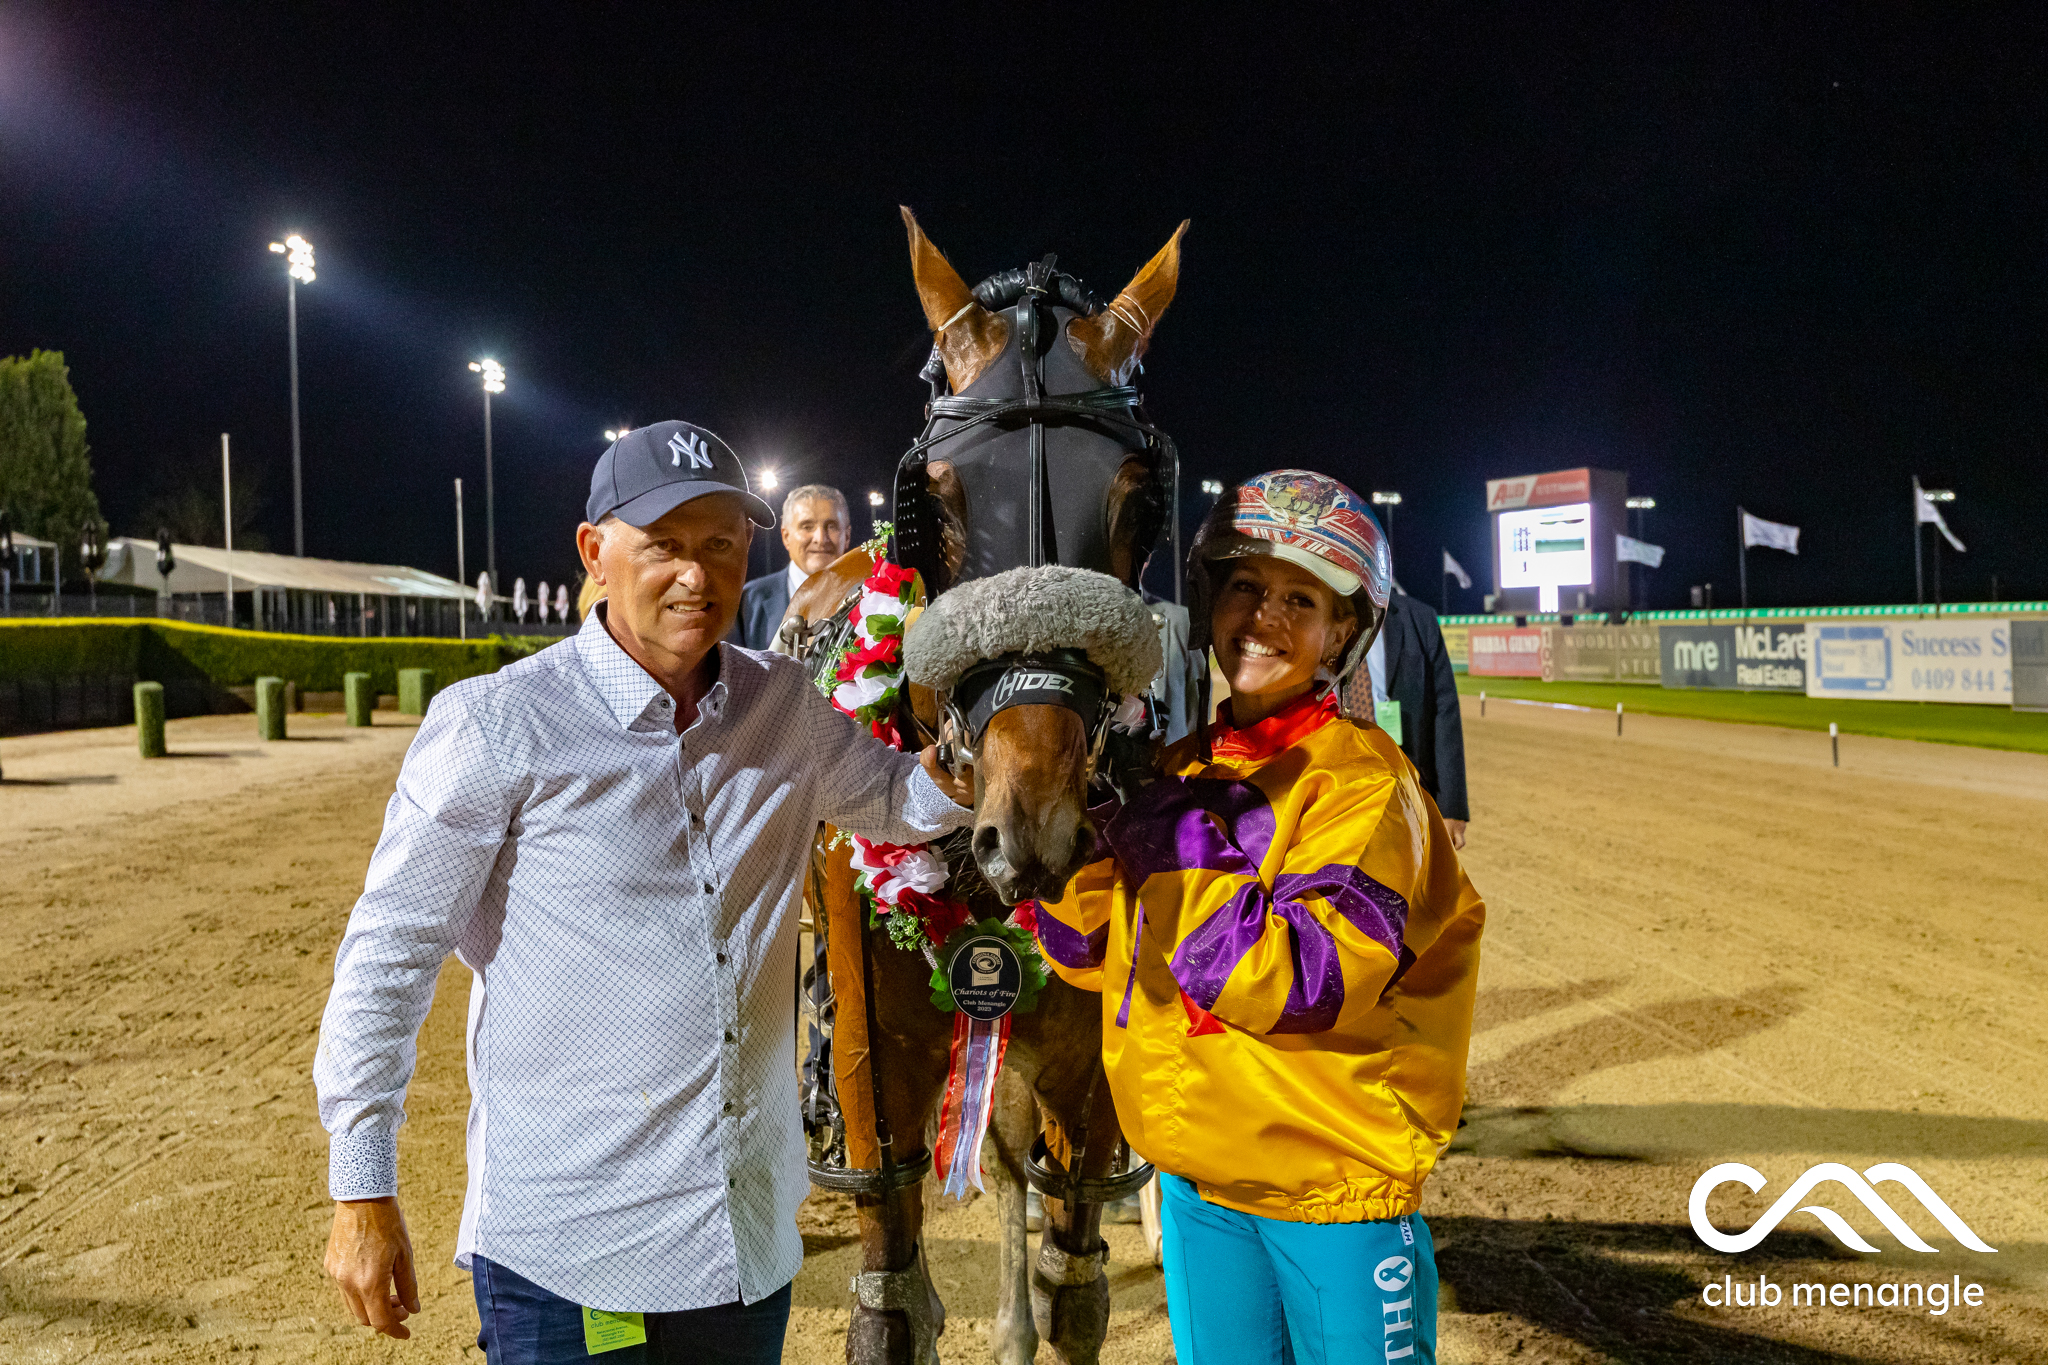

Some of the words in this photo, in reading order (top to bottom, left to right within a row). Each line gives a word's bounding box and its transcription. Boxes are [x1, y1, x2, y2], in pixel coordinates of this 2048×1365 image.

[668, 432, 714, 469] NY
[1674, 640, 1720, 671] mre
[1902, 629, 1982, 657] Success
[995, 669, 1075, 706] HIDEZ
[1736, 664, 1763, 685] Real
[1764, 665, 1803, 686] Estate
[1912, 667, 1956, 691] 0409
[1961, 668, 1995, 692] 844
[954, 988, 987, 996] Chariots
[988, 989, 1000, 998] of
[999, 990, 1017, 998] Fire
[591, 1320, 604, 1329] club
